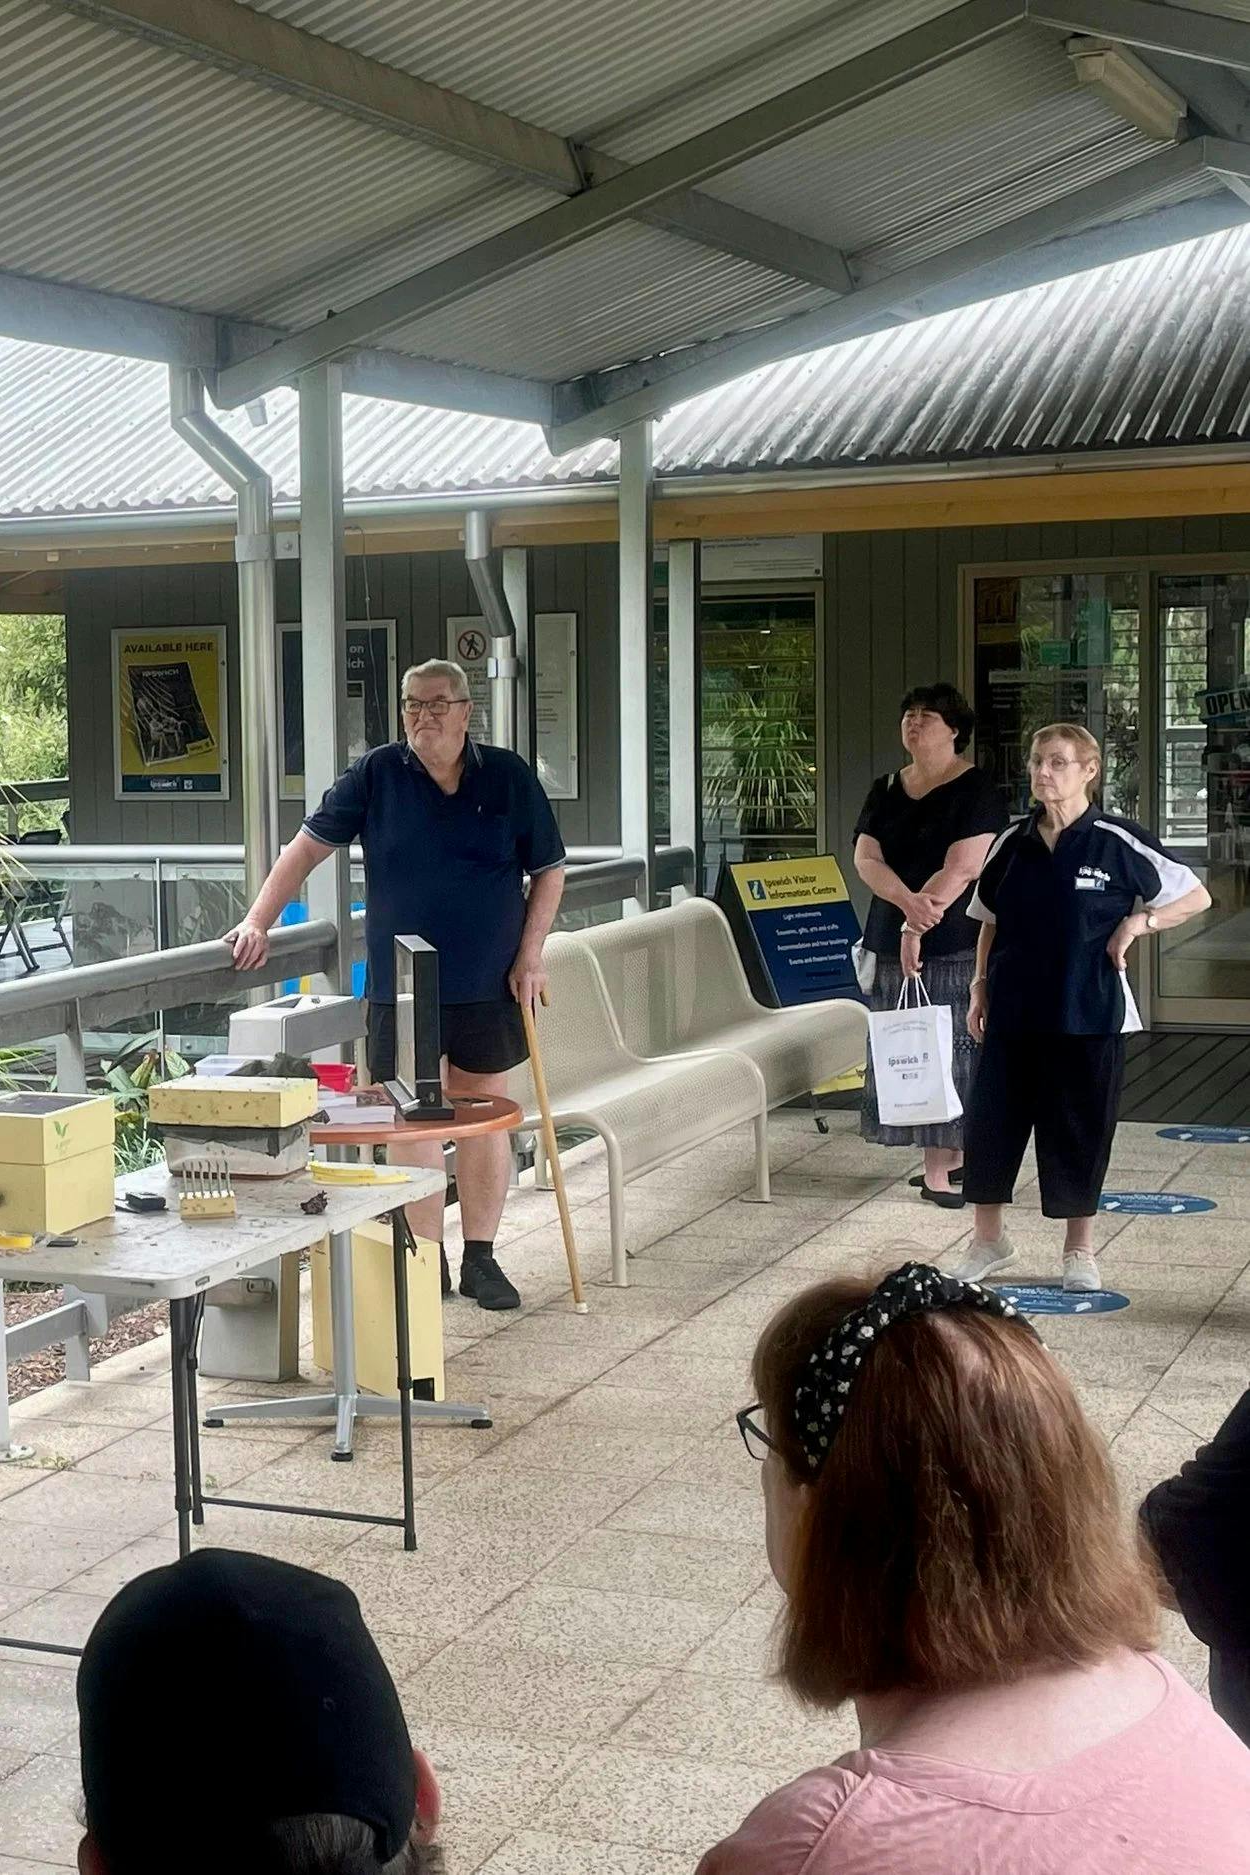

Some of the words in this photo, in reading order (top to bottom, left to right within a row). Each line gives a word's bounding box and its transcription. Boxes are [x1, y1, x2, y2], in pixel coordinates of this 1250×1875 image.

[124, 642, 183, 654] AVAILABLE
[185, 642, 214, 652] HERE
[764, 876, 792, 888] Ipswich
[792, 875, 817, 885] Visitor
[768, 888, 811, 900] Information
[812, 886, 837, 895] Centre
[888, 1056, 919, 1067] Ipswich
